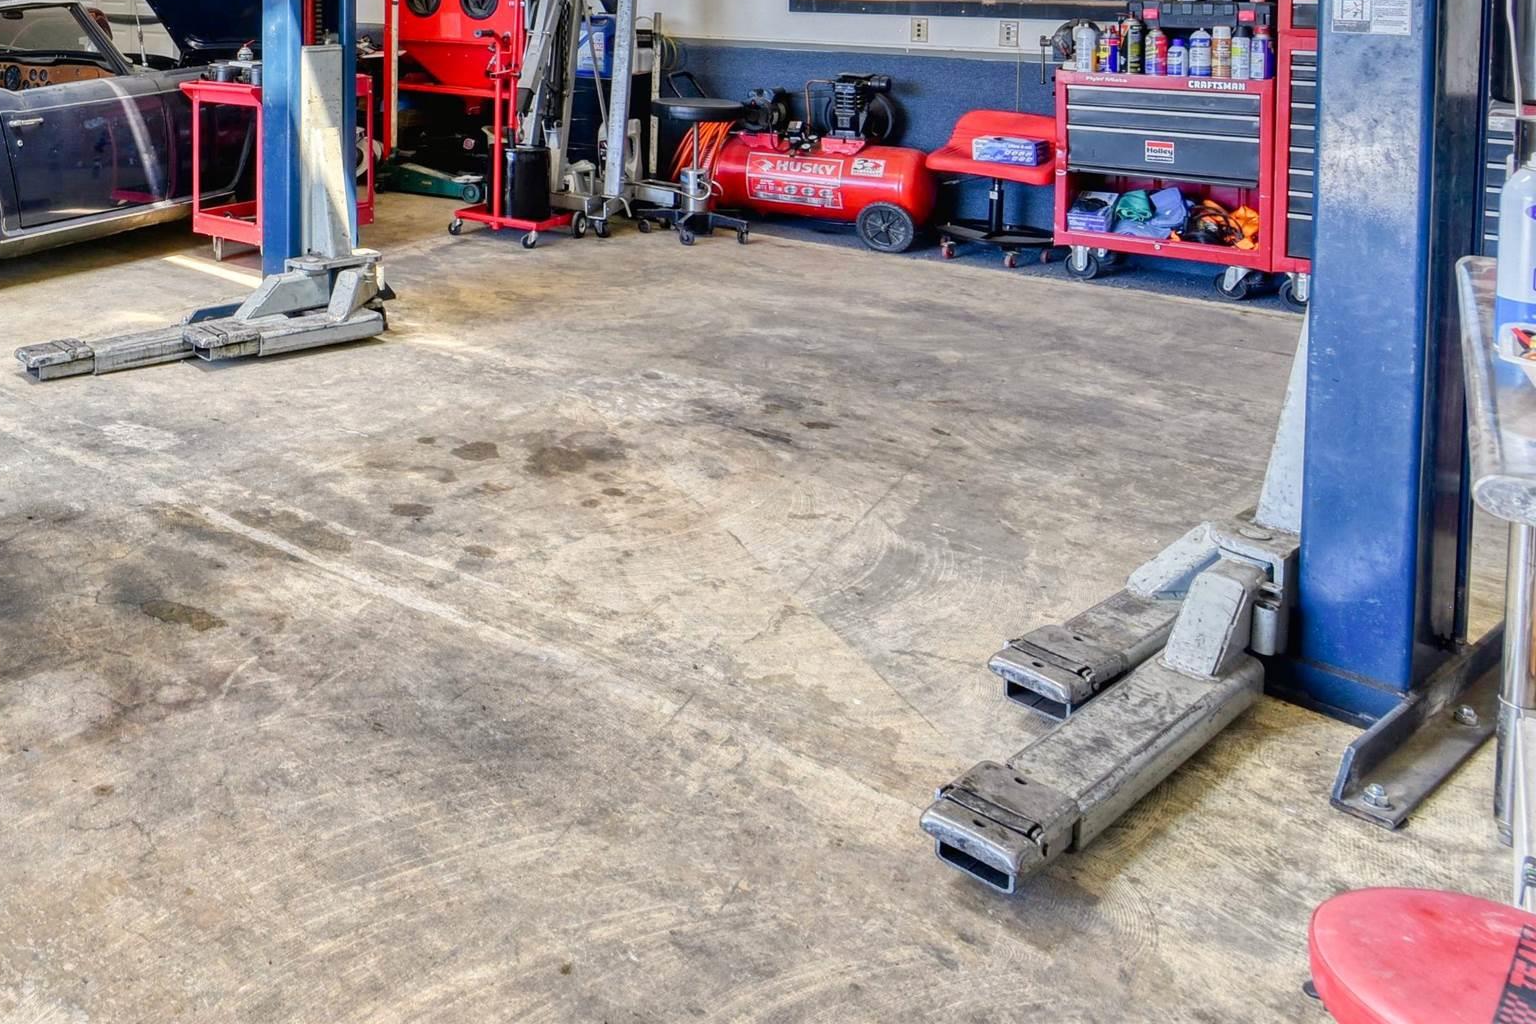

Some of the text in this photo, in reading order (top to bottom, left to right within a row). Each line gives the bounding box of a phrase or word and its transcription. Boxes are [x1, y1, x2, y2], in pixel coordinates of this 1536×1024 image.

[1188, 80, 1246, 91] CRAFTSMAN
[1146, 147, 1174, 157] Holley
[775, 159, 837, 176] HUSKY
